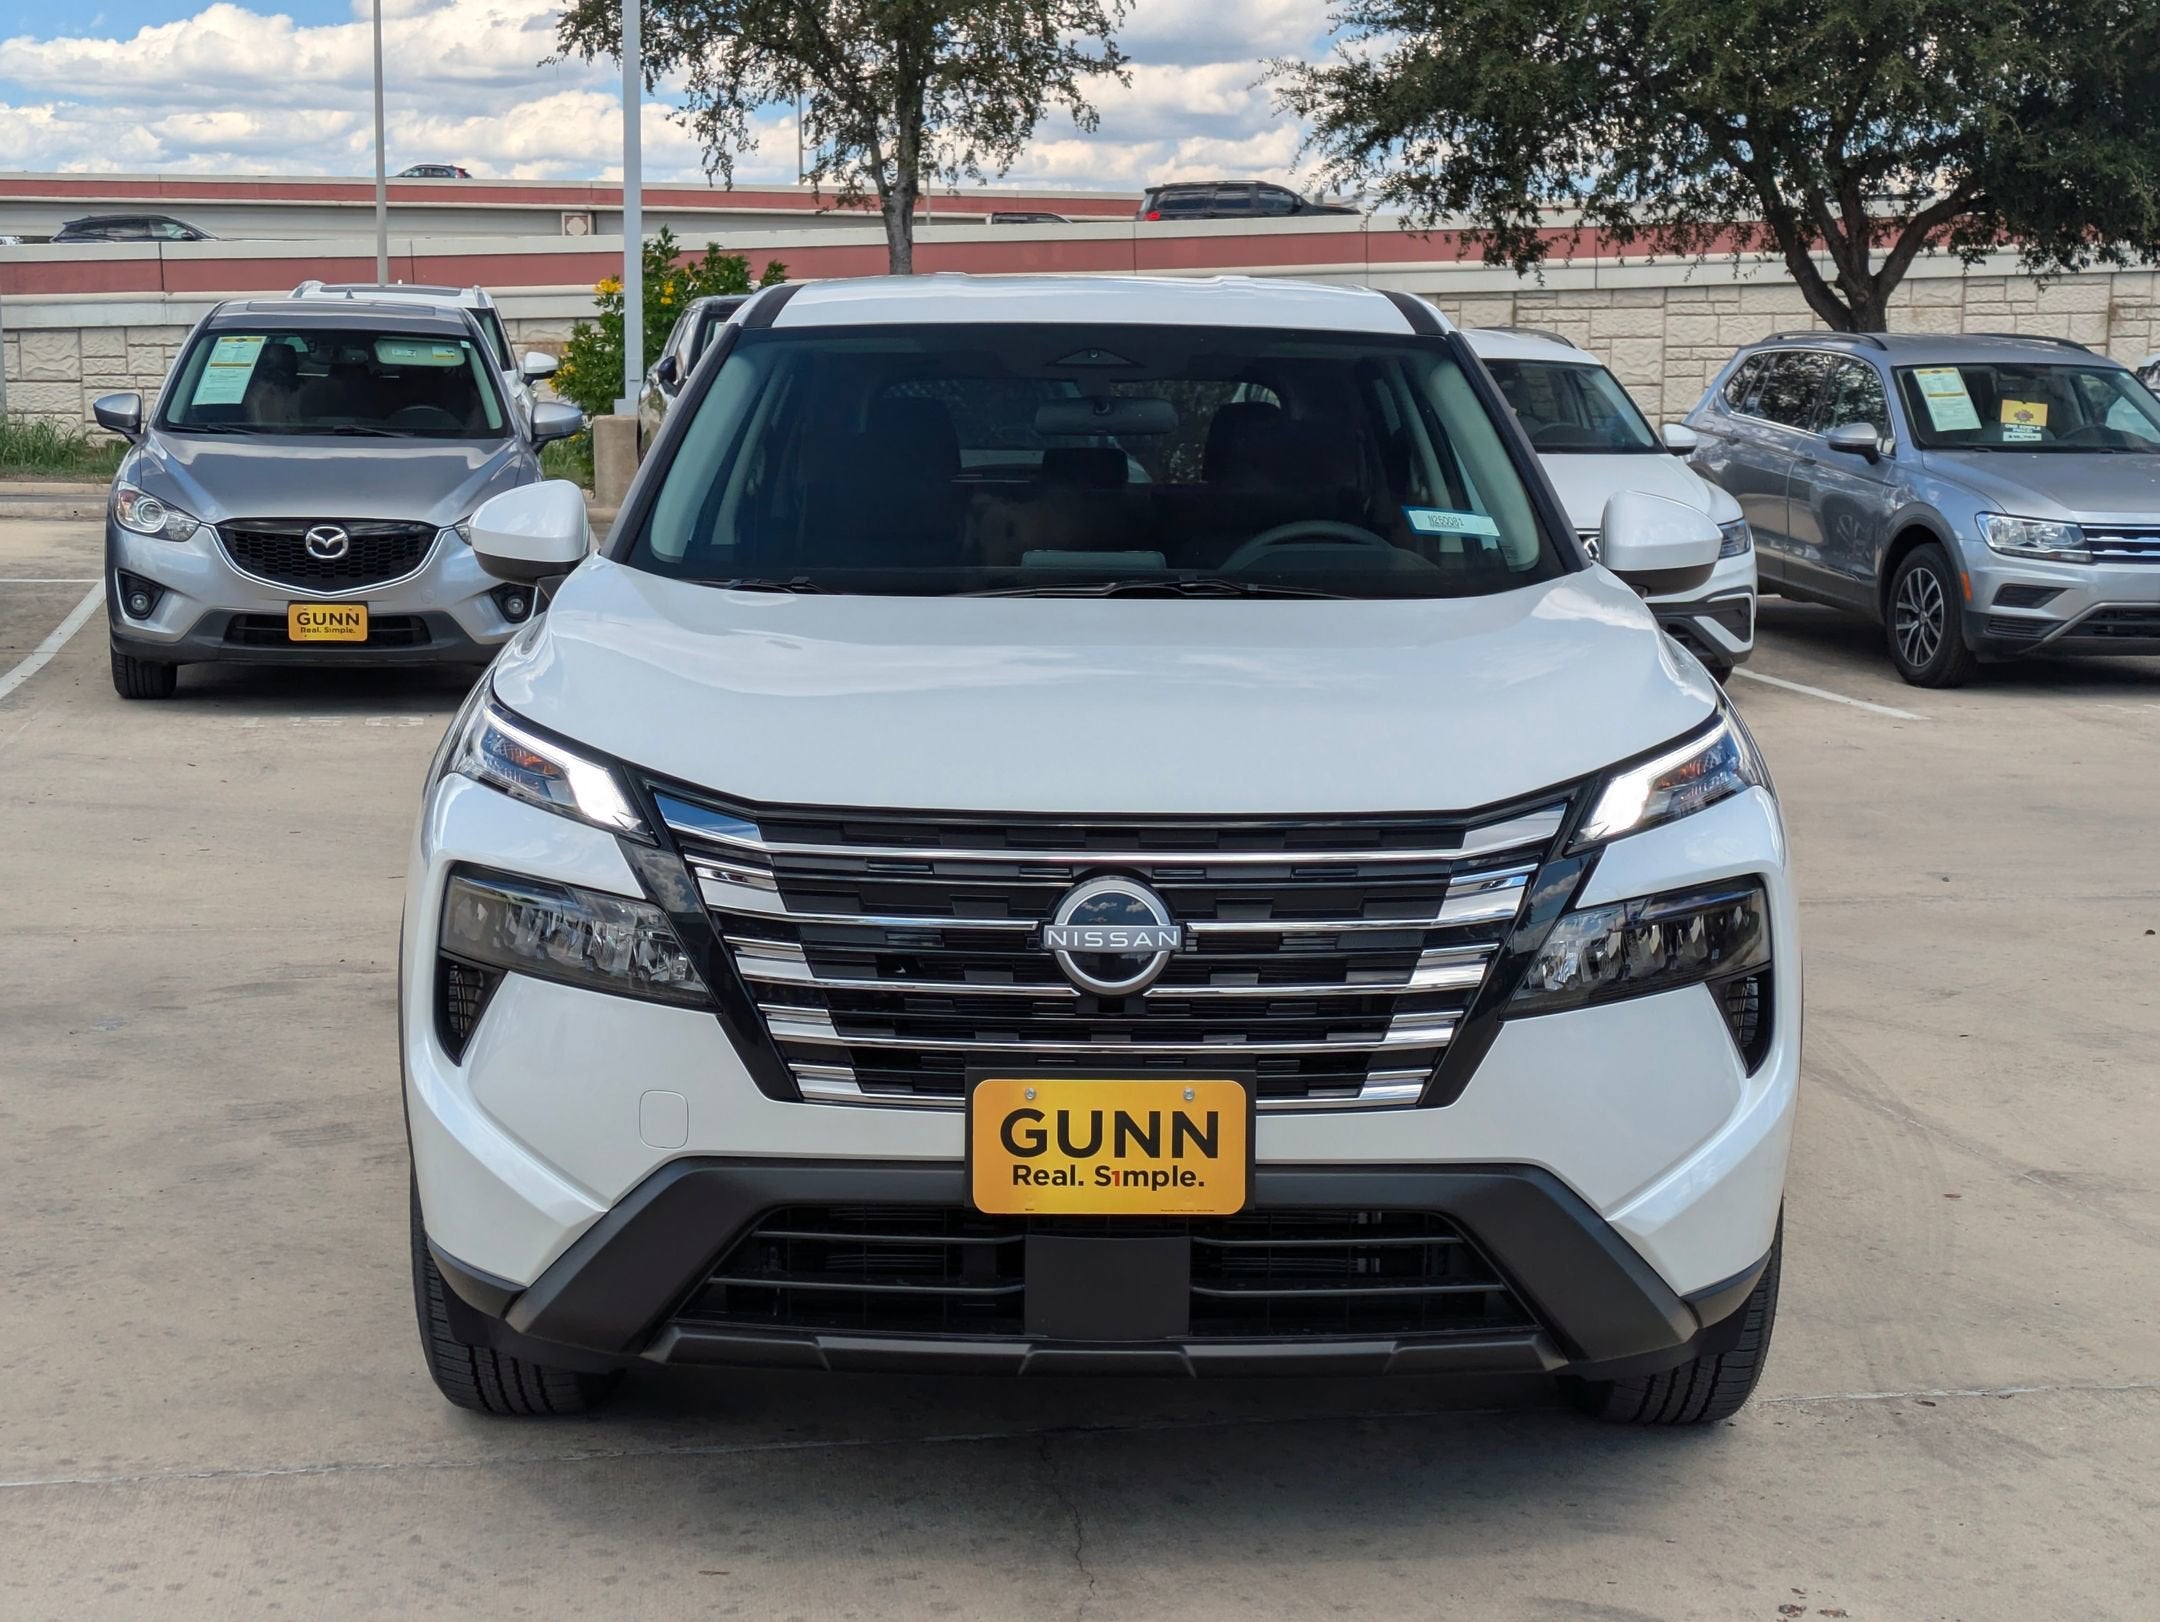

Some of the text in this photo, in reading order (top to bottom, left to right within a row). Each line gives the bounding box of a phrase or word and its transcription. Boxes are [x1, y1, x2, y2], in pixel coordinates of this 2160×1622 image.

[296, 612, 360, 626] GUNN
[300, 626, 322, 634] Real.
[1047, 930, 1178, 948] NISSAN
[1000, 1108, 1219, 1159] GUNN
[1012, 1165, 1084, 1187] Real.
